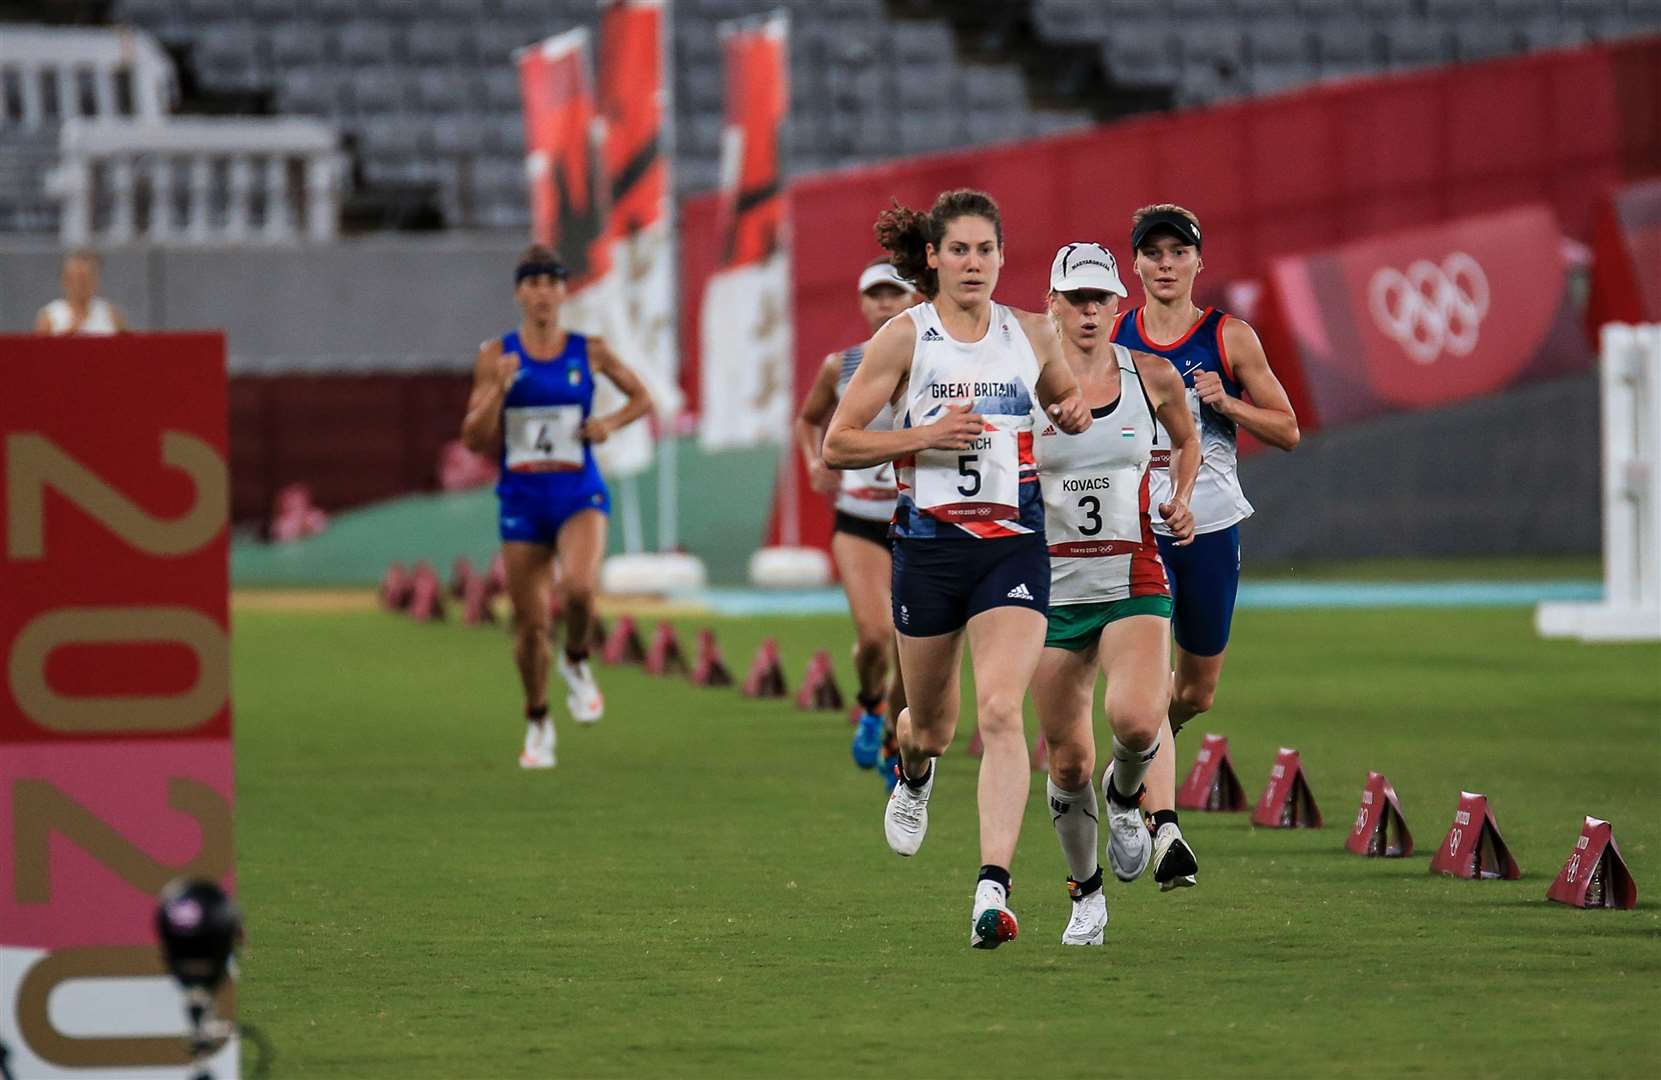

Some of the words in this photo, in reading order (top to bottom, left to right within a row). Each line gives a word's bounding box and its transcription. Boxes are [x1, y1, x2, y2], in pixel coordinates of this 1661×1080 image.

[932, 383, 970, 398] GREAT
[974, 383, 1017, 398] BRITAIN
[534, 424, 554, 454] 4
[957, 454, 982, 497] 5
[1063, 477, 1110, 491] KOVACS
[1078, 495, 1103, 536] 3
[1007, 592, 1034, 600] adidas
